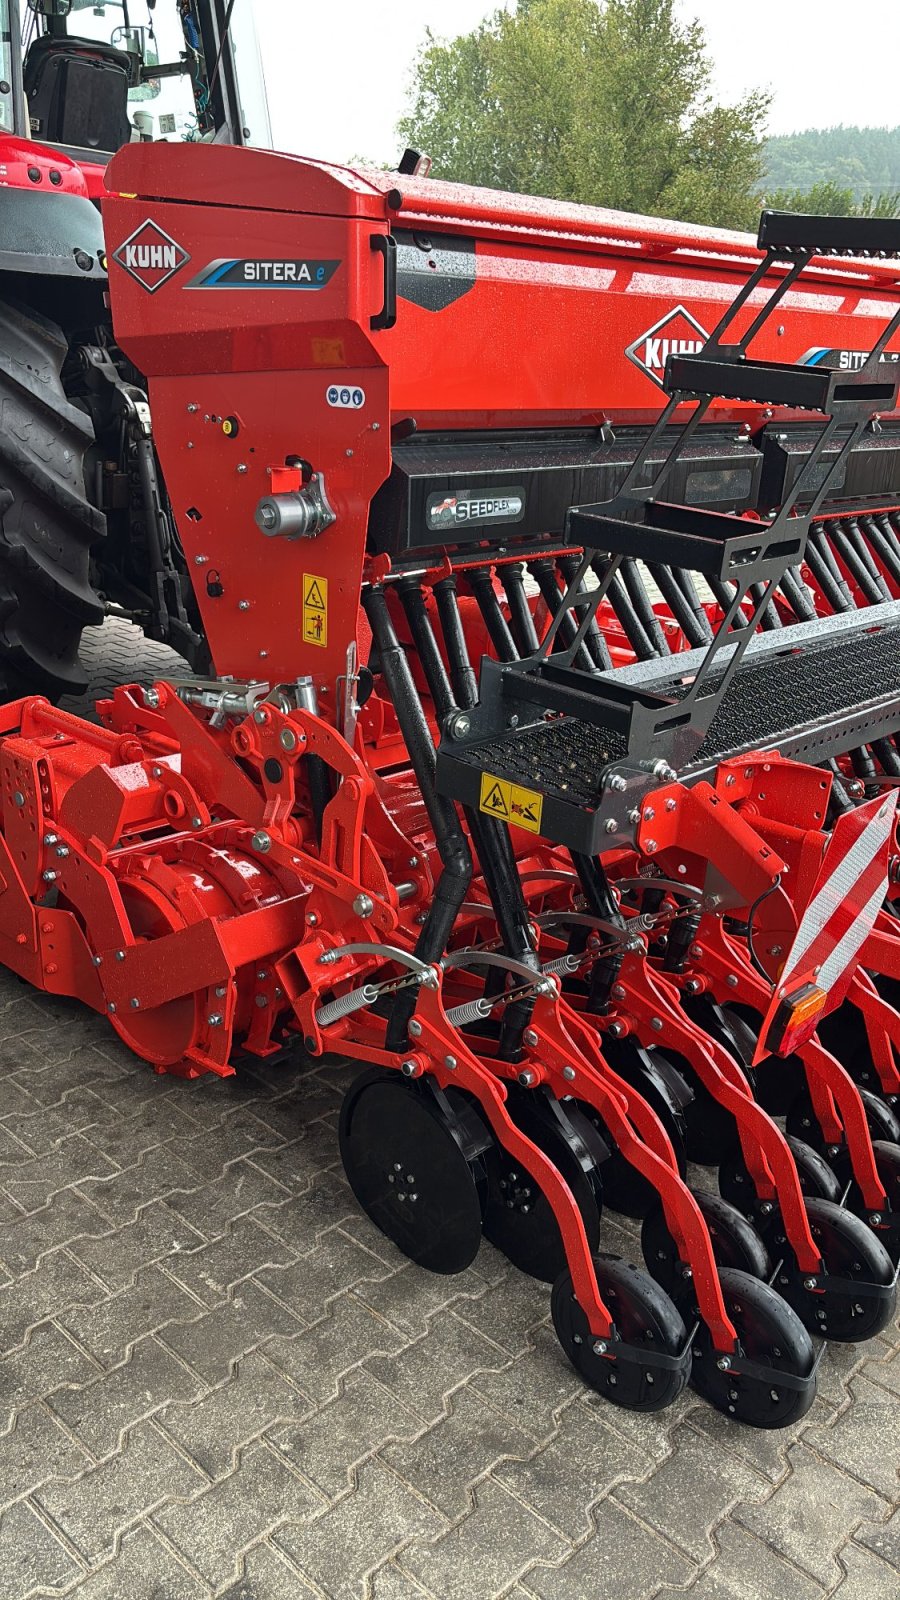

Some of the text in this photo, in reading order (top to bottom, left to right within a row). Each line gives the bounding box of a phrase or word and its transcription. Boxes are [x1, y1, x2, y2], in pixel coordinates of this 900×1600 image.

[125, 244, 176, 269] KUHN
[243, 262, 325, 282] SITERA e
[839, 351, 887, 369] SITEA
[456, 499, 509, 521] SEEDFLEX
